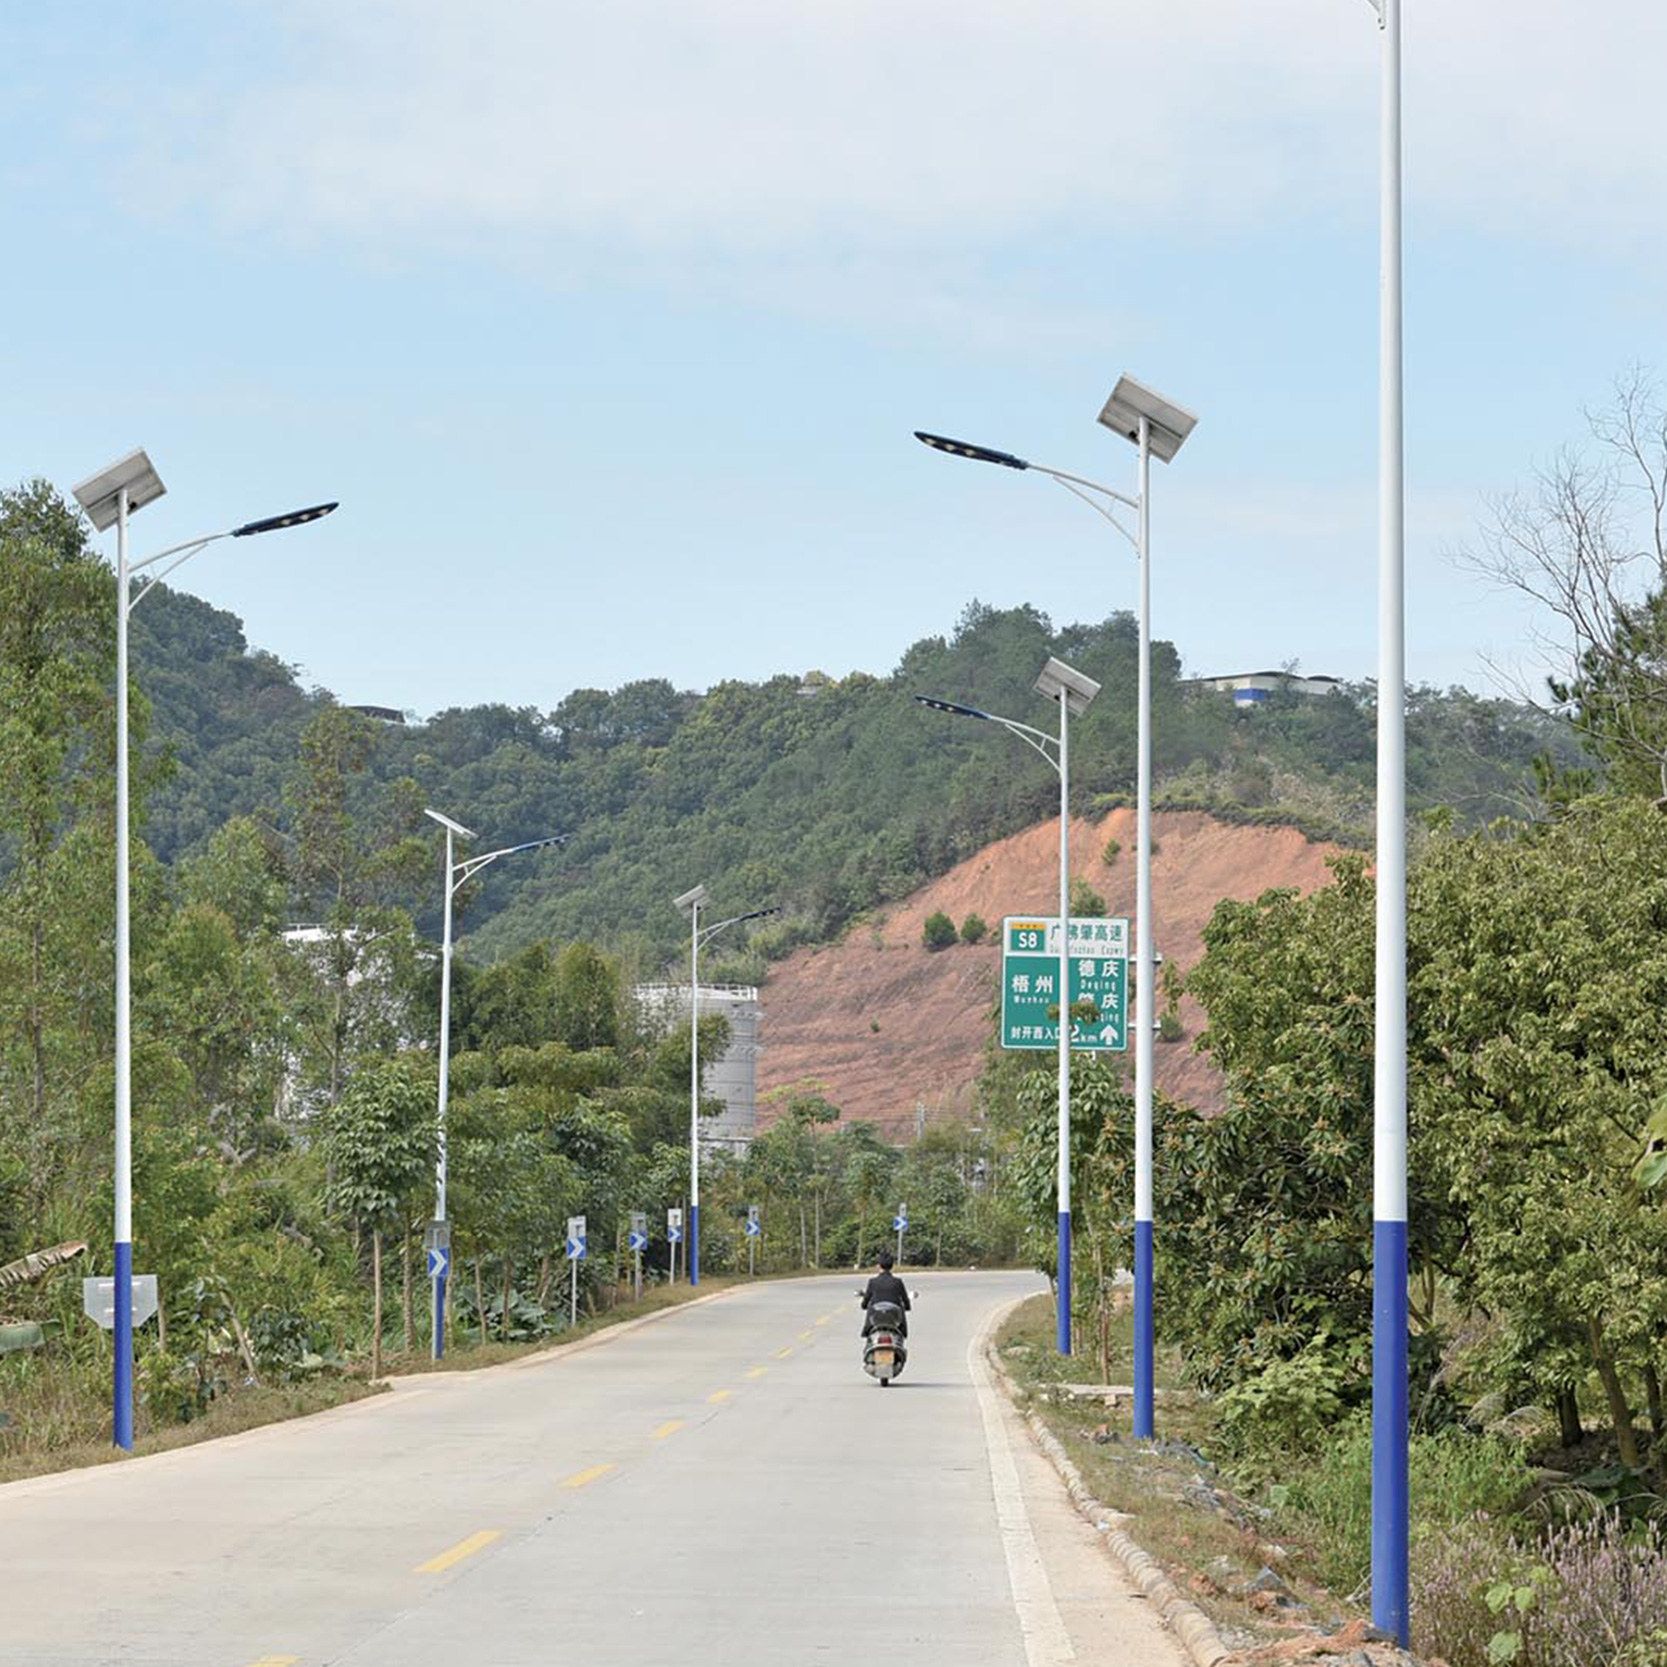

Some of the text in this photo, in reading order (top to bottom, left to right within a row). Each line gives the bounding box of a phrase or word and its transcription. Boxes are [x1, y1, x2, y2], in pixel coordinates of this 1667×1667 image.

[1019, 931, 1037, 948] S8
[1078, 959, 1119, 977] 德庆
[1012, 974, 1053, 993] 梧州
